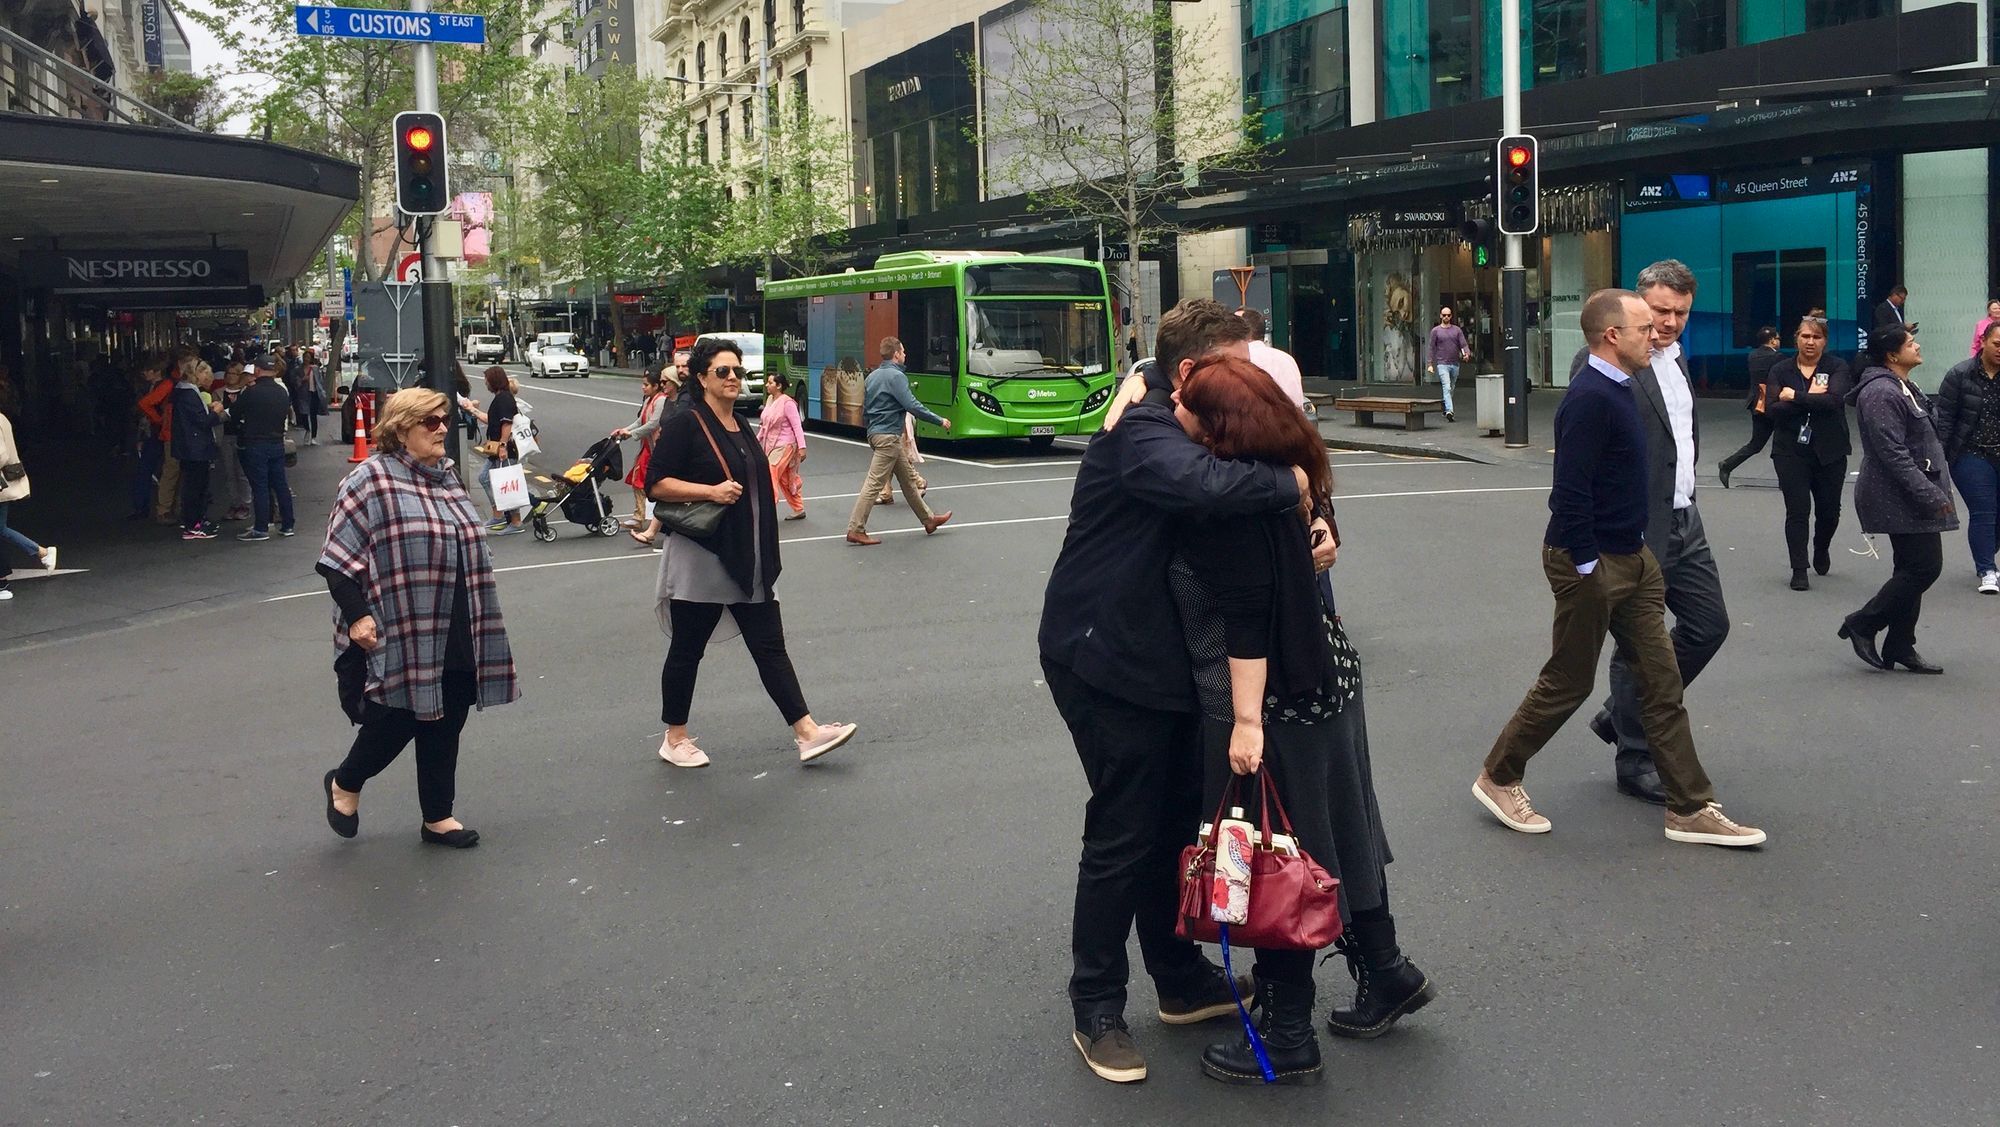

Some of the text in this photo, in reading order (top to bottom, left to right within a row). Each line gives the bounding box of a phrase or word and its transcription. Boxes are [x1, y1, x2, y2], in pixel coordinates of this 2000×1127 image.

[324, 9, 331, 19] 5
[322, 25, 335, 34] 105
[349, 13, 475, 36] CUSTOMS ST EAST
[1830, 170, 1858, 184] ANZ
[1640, 186, 1662, 197] ANZ
[1734, 177, 1808, 194] 45 Queen Street
[1404, 212, 1445, 221] SWAROVSKI
[1103, 246, 1128, 259] Dior
[1856, 203, 1869, 300] 45 Queen Street
[63, 257, 211, 281] NESPRESSO
[789, 334, 807, 351] Metro
[1857, 327, 1868, 352] AN
[516, 427, 532, 441] 30
